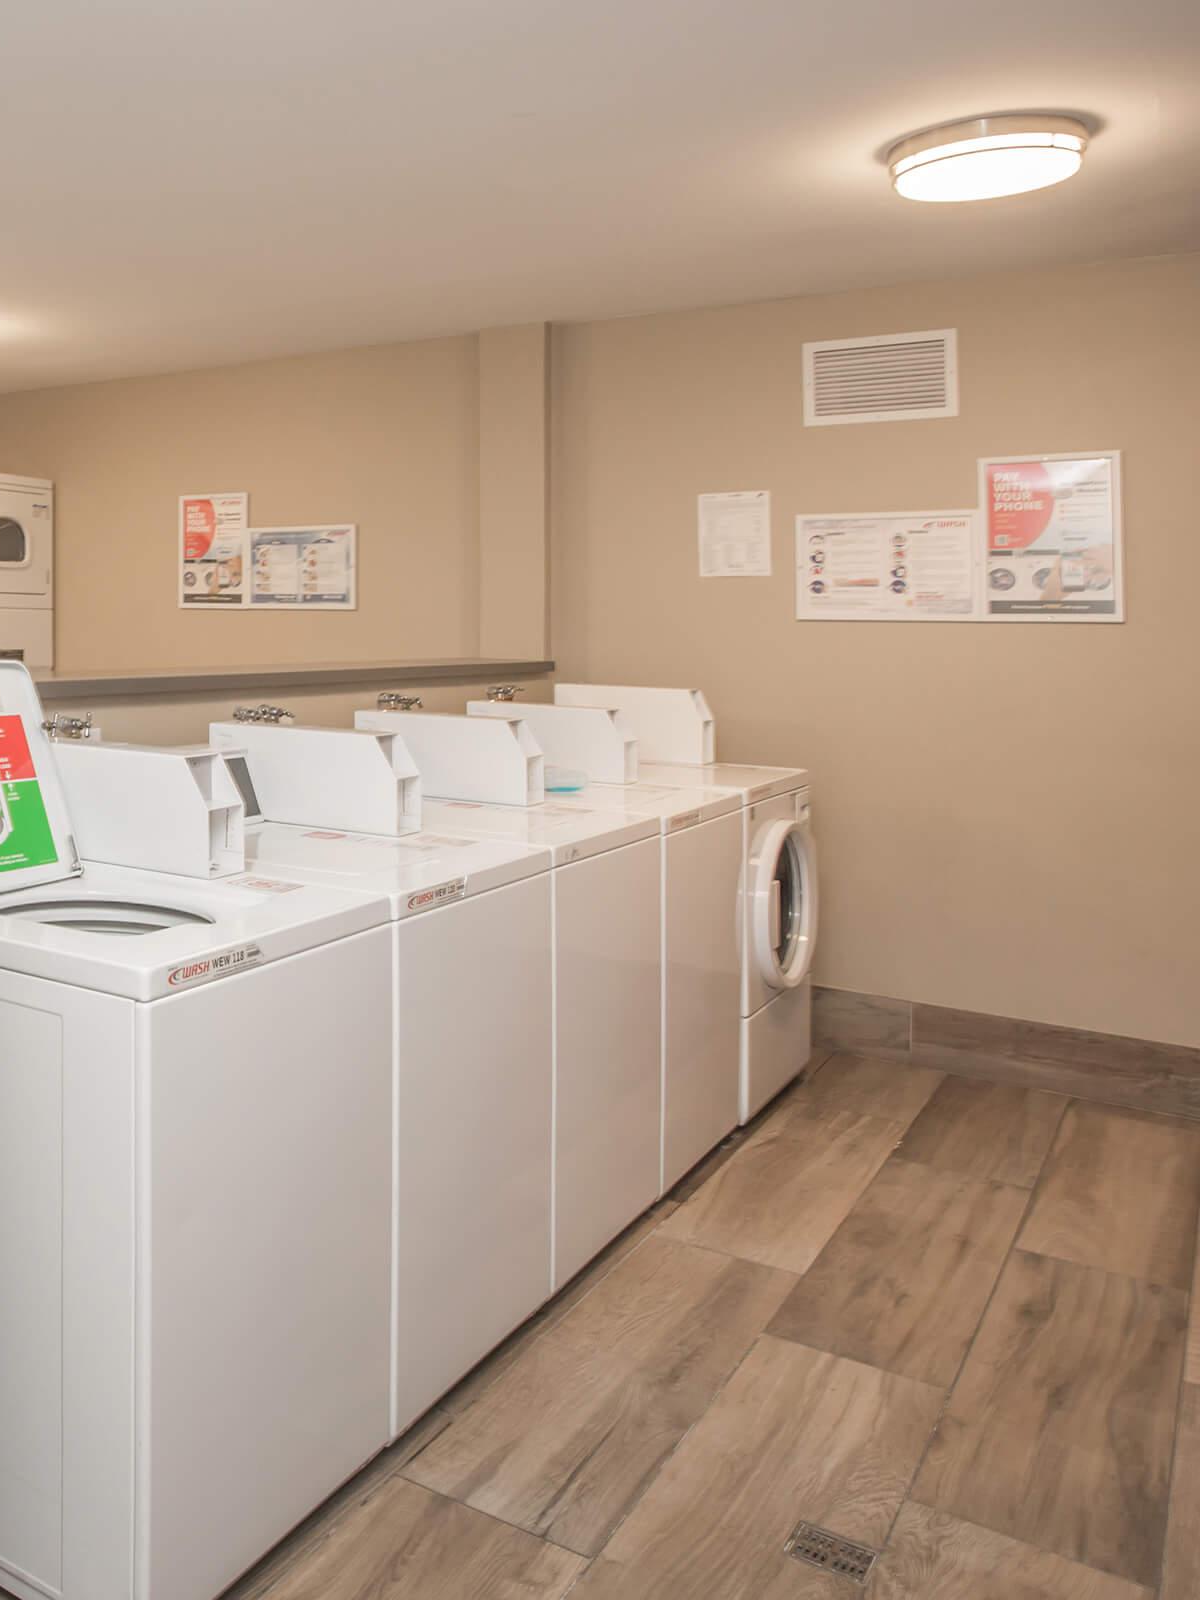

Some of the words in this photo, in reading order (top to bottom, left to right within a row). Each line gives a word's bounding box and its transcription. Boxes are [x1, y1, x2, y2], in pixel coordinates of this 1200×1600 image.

[993, 492, 1032, 502] YOUR
[993, 501, 1044, 512] PHONE
[182, 961, 210, 979] WASH
[211, 953, 231, 969] WEW
[232, 950, 245, 964] 118
